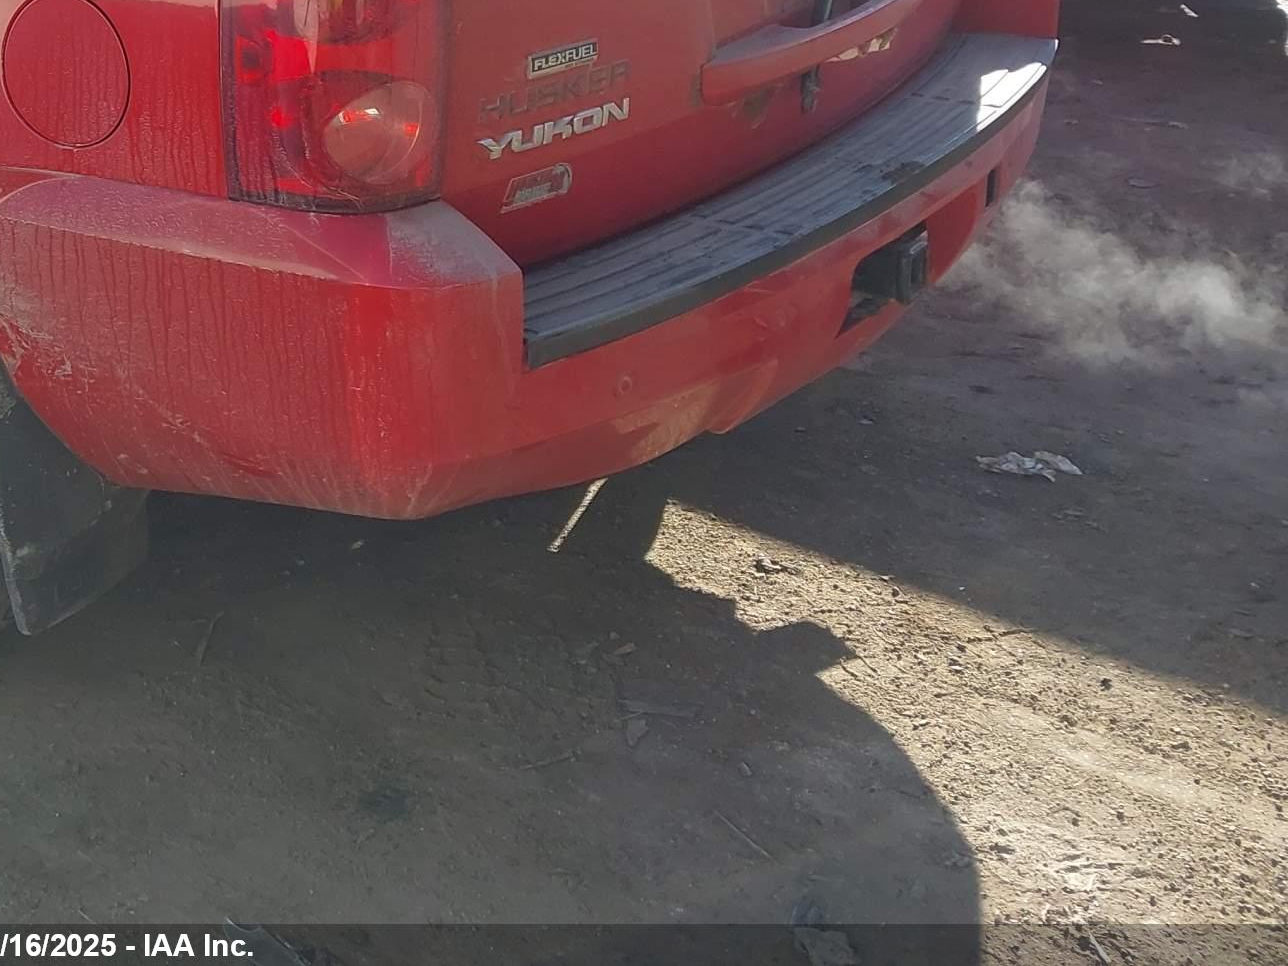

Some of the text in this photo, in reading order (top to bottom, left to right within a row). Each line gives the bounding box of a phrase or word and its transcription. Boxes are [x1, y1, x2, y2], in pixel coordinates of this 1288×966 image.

[533, 44, 599, 72] FLEXFUEL
[479, 60, 630, 122] HUSKER
[476, 97, 631, 160] YUKON
